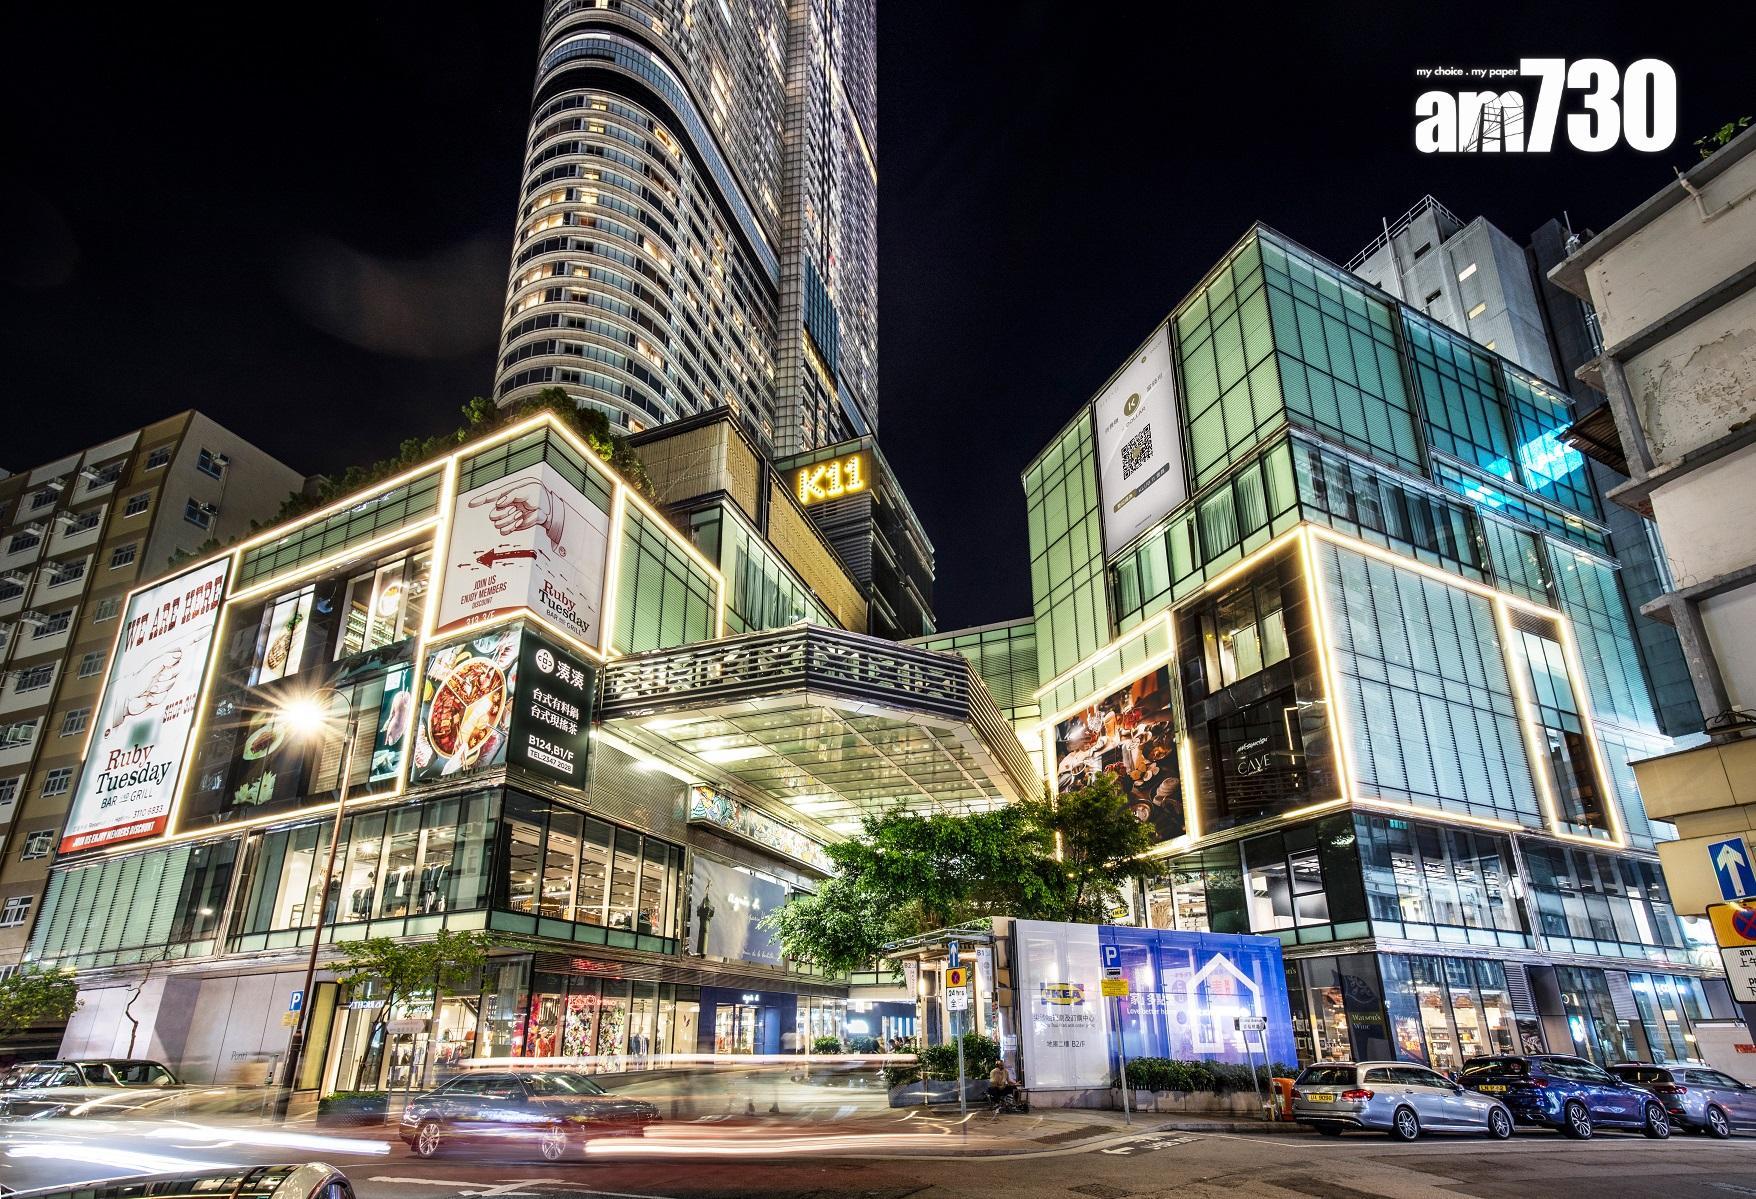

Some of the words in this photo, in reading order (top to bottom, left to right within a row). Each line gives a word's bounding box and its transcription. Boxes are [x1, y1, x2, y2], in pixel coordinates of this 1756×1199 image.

[799, 455, 864, 505] K11
[460, 591, 478, 605] ENJOY
[479, 582, 508, 599] MEMBERS
[473, 578, 487, 590] JOIN
[487, 574, 497, 585] US
[543, 579, 576, 611] Ruby
[125, 613, 149, 652] WE
[149, 597, 180, 640] ARE
[181, 575, 223, 625] HERE
[538, 589, 590, 633] Tuesday
[546, 609, 558, 620] BAR
[566, 622, 581, 637] GRILL
[532, 688, 579, 720] 台式有料鍋
[104, 744, 154, 772] Ruby
[528, 734, 574, 761] B124,B1/F
[557, 760, 572, 772] 2028
[1238, 753, 1271, 775] CAVE
[95, 761, 172, 795] Tuesday
[100, 796, 118, 809] BAR
[130, 789, 153, 802] GRILL
[1105, 946, 1117, 966] P
[291, 993, 301, 1009] P
[955, 989, 965, 997] hrs
[1071, 1040, 1086, 1048] B2/F
